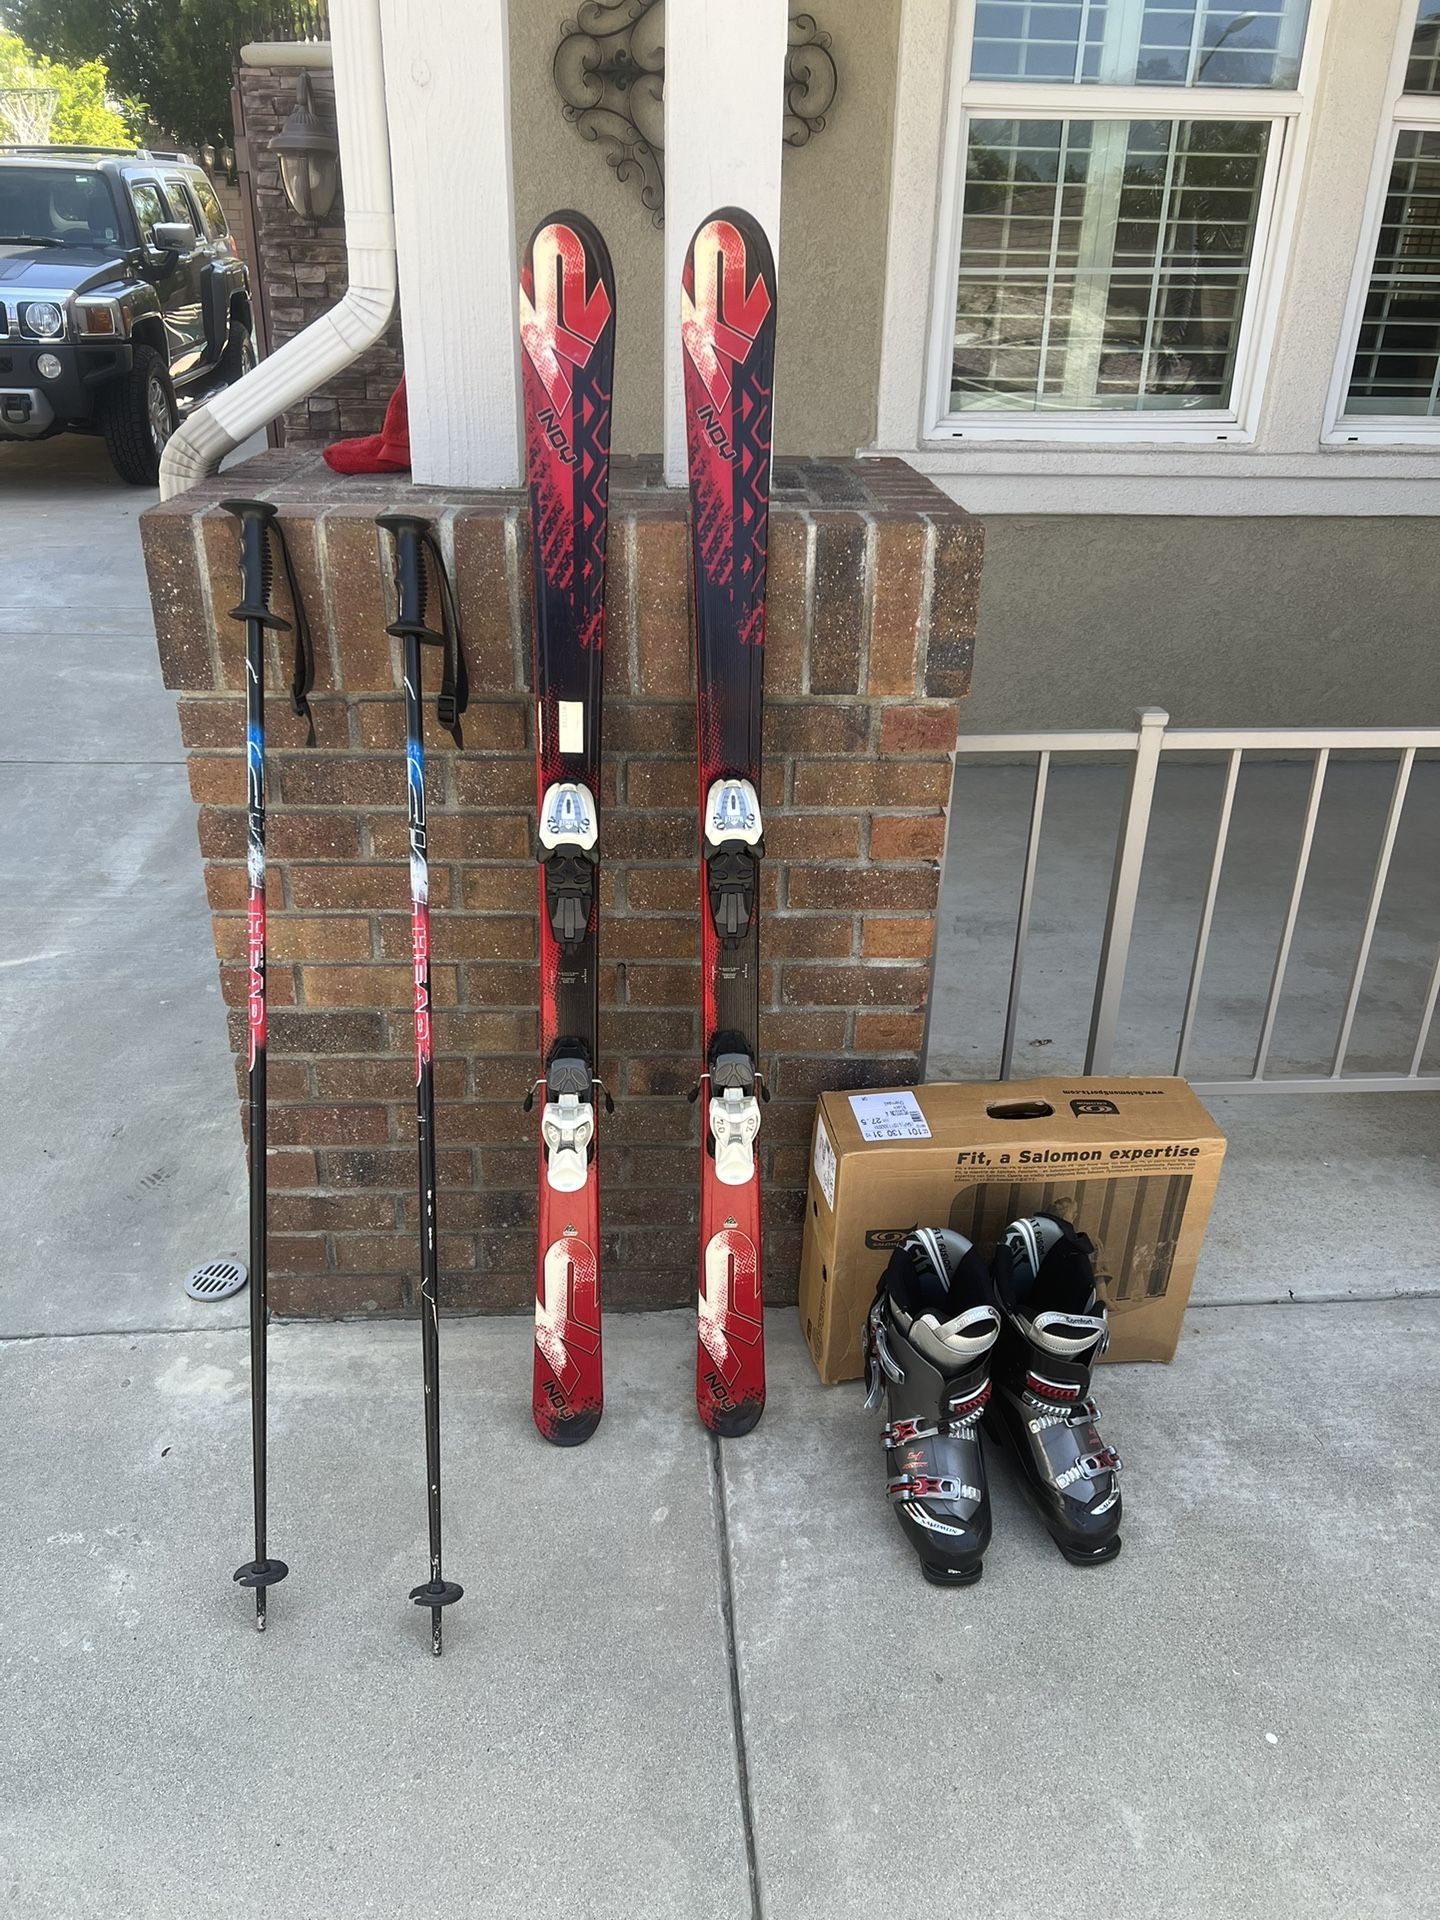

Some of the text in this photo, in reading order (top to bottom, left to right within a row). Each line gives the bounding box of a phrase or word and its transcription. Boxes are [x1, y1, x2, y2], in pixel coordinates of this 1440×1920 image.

[536, 404, 578, 465] INDY
[696, 404, 738, 462] INDY
[248, 912, 264, 1025] HEAD
[411, 927, 429, 1040] HEAD
[872, 1130, 884, 1139] 31
[886, 1129, 903, 1138] 130
[907, 1128, 923, 1137] 101
[956, 1144, 1201, 1166] Fit, a Salomon expertise
[542, 1379, 575, 1422] INDY
[703, 1371, 736, 1413] INDY
[921, 1518, 958, 1534] SALOMON
